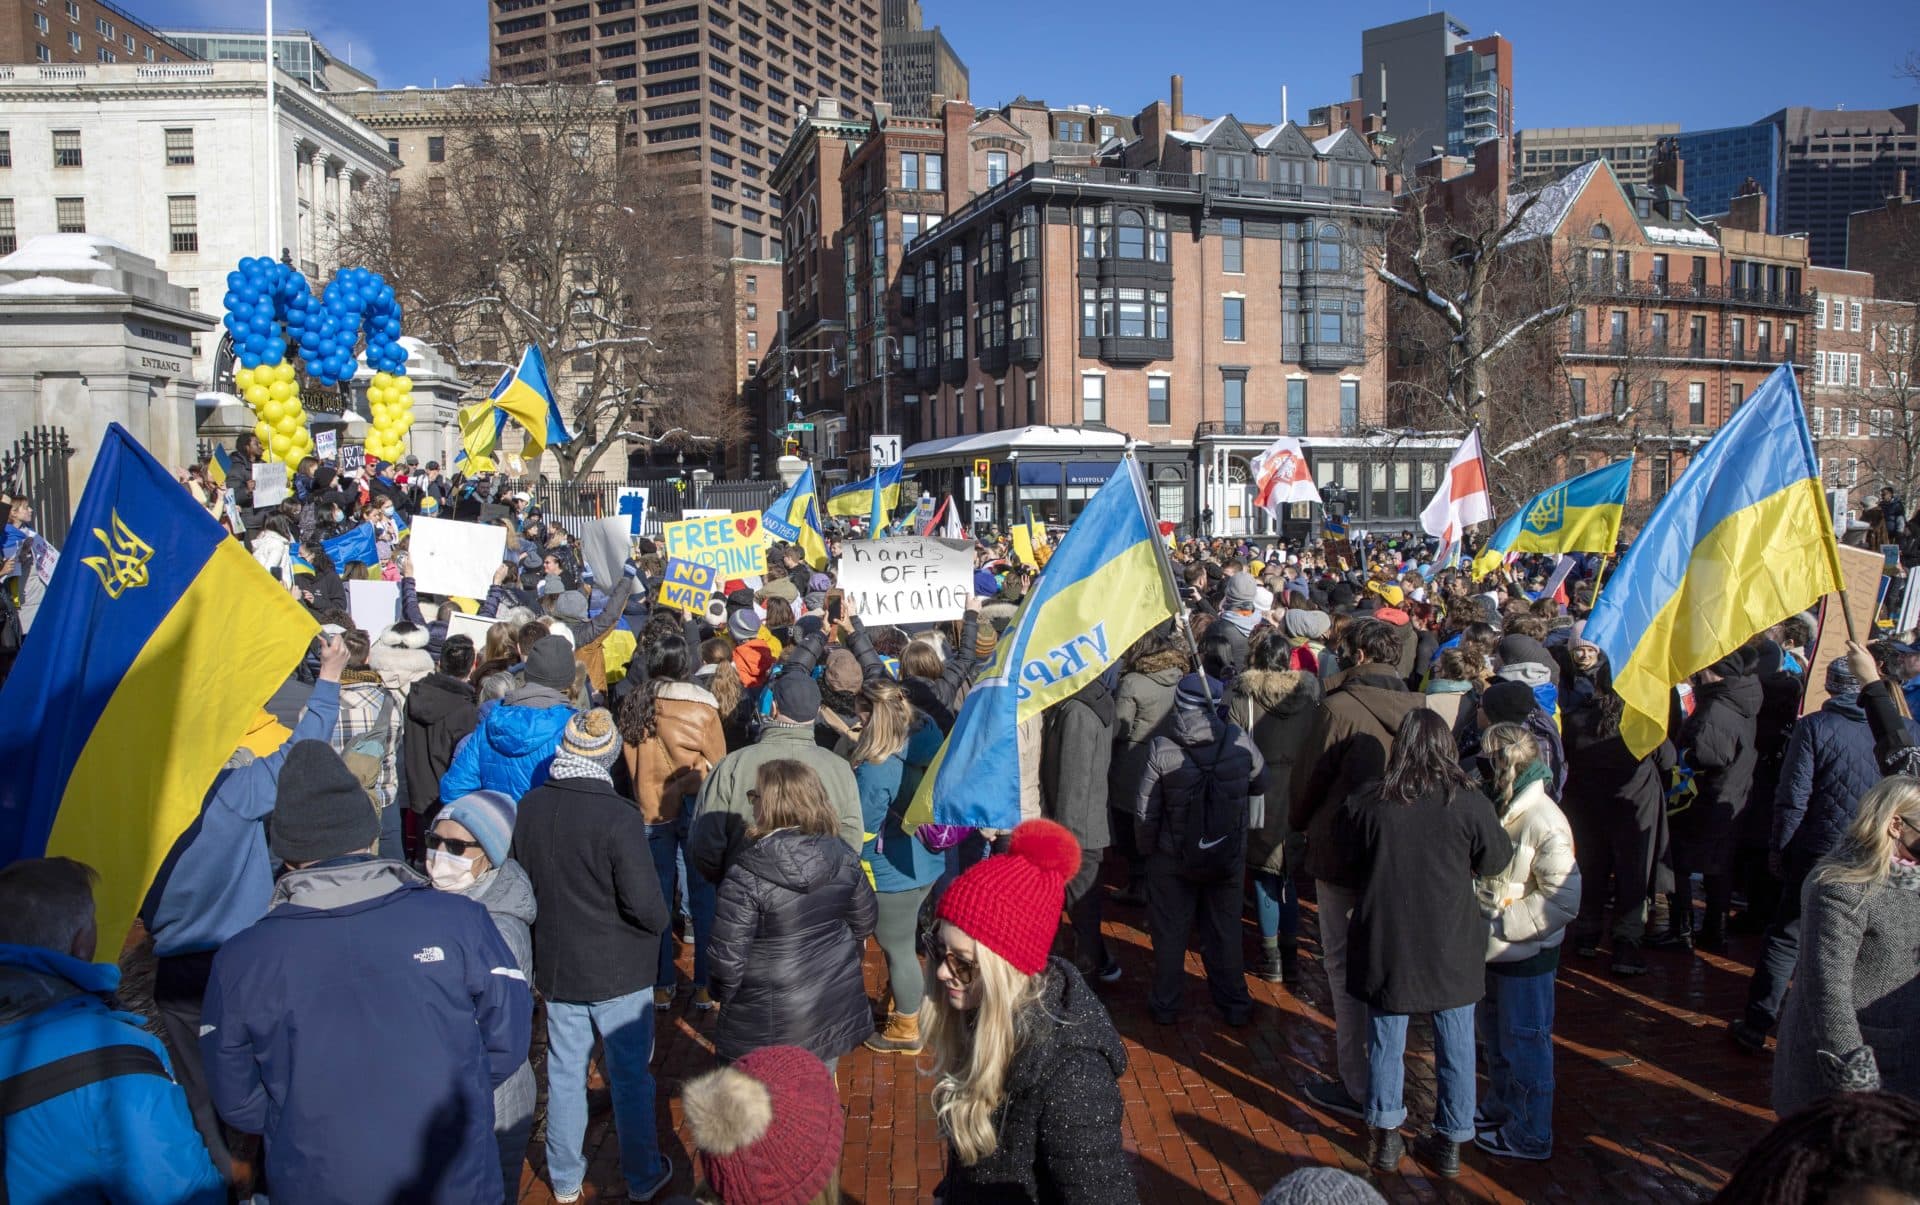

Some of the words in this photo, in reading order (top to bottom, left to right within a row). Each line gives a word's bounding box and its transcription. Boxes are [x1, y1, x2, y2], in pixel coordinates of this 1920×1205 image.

[142, 357, 181, 372] ENTRANCE
[668, 519, 735, 553] FREE
[763, 516, 779, 530] AND
[778, 524, 798, 540] THEN
[682, 544, 763, 575] RAINE
[852, 543, 944, 563] hands
[674, 562, 708, 585] NO
[880, 564, 940, 584] OFF
[666, 584, 706, 611] WAR
